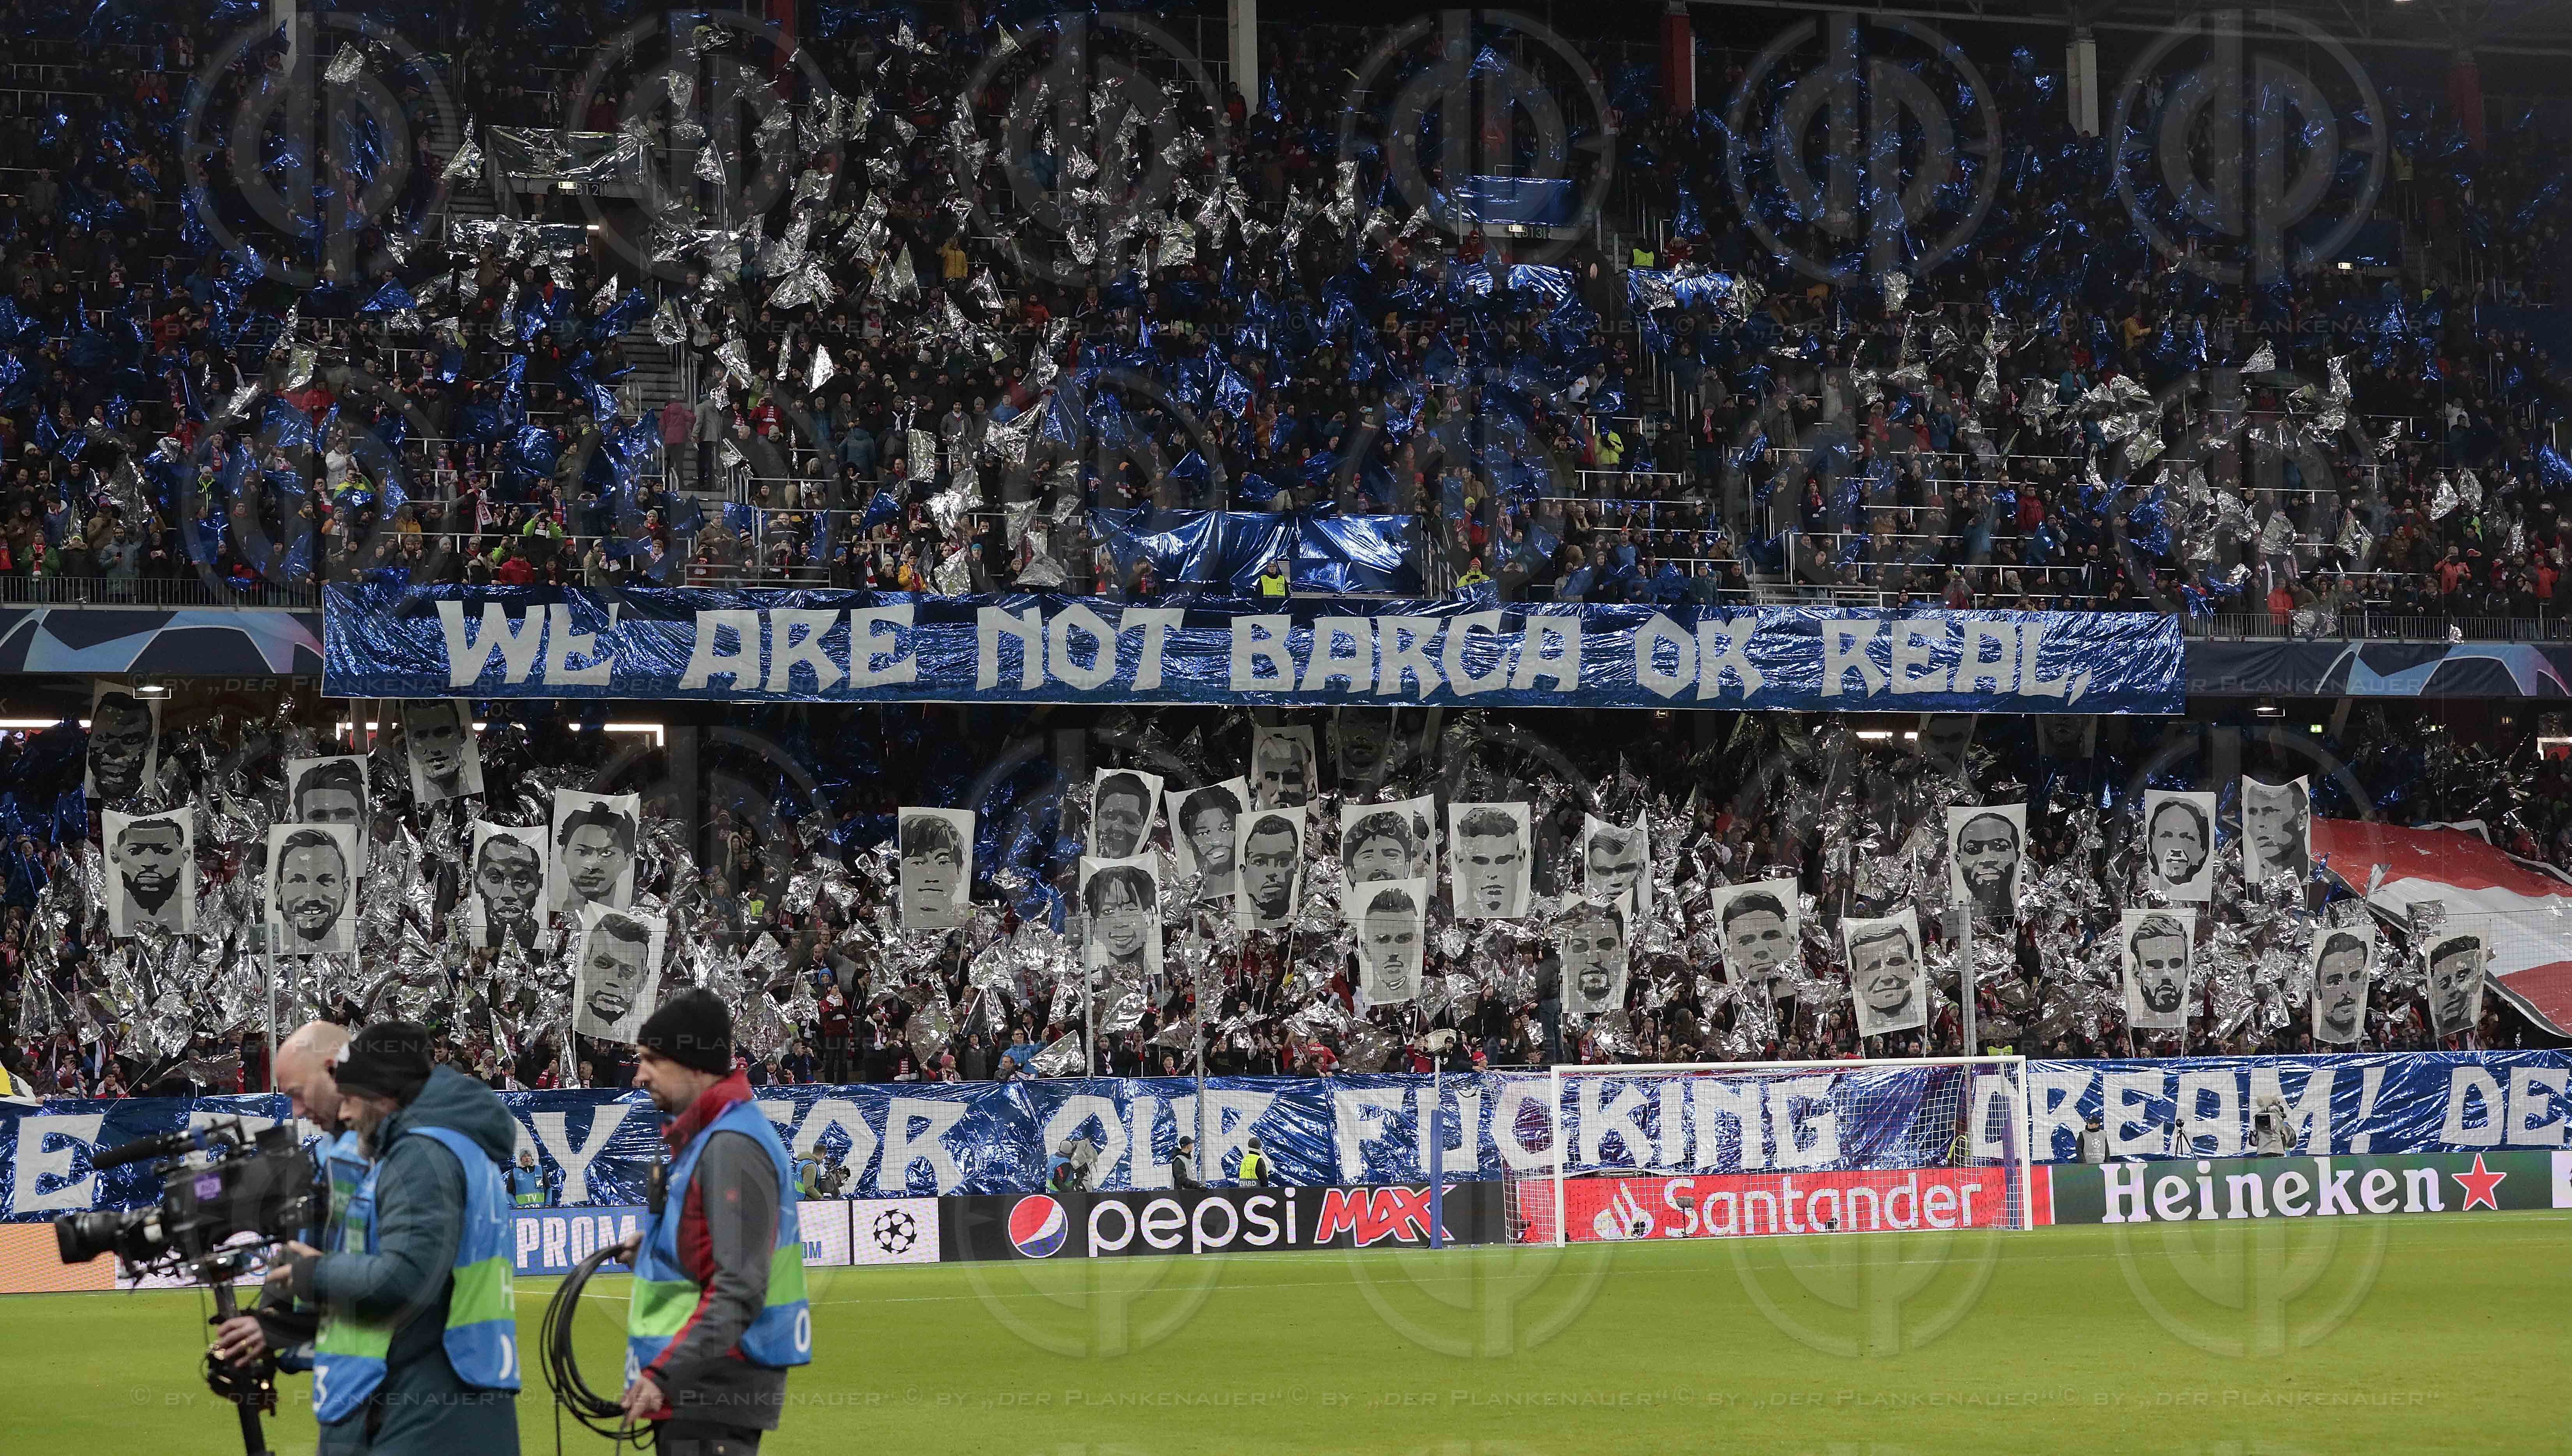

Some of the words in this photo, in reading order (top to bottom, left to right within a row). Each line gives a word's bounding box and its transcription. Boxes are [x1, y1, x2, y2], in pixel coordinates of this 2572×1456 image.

[576, 184, 599, 195] B12
[436, 600, 619, 688] WE
[678, 604, 916, 693] ARE
[975, 604, 1185, 692] NOT
[1229, 609, 1581, 700] BARCA
[1635, 611, 1765, 701] OR
[1821, 618, 2092, 706] REAL,
[0, 1114, 104, 1214] E
[752, 1097, 968, 1197] OR
[1043, 1091, 1277, 1189] OUR
[1333, 1077, 1841, 1179] FUCKING
[1971, 1066, 2386, 1162] DREAM!
[2439, 1066, 2572, 1147] DE
[526, 1194, 537, 1202] TV
[1088, 1188, 1297, 1257] pepsi
[1314, 1184, 1457, 1247] MAX
[1665, 1172, 1982, 1237] Santander
[2099, 1157, 2445, 1223] Heineken
